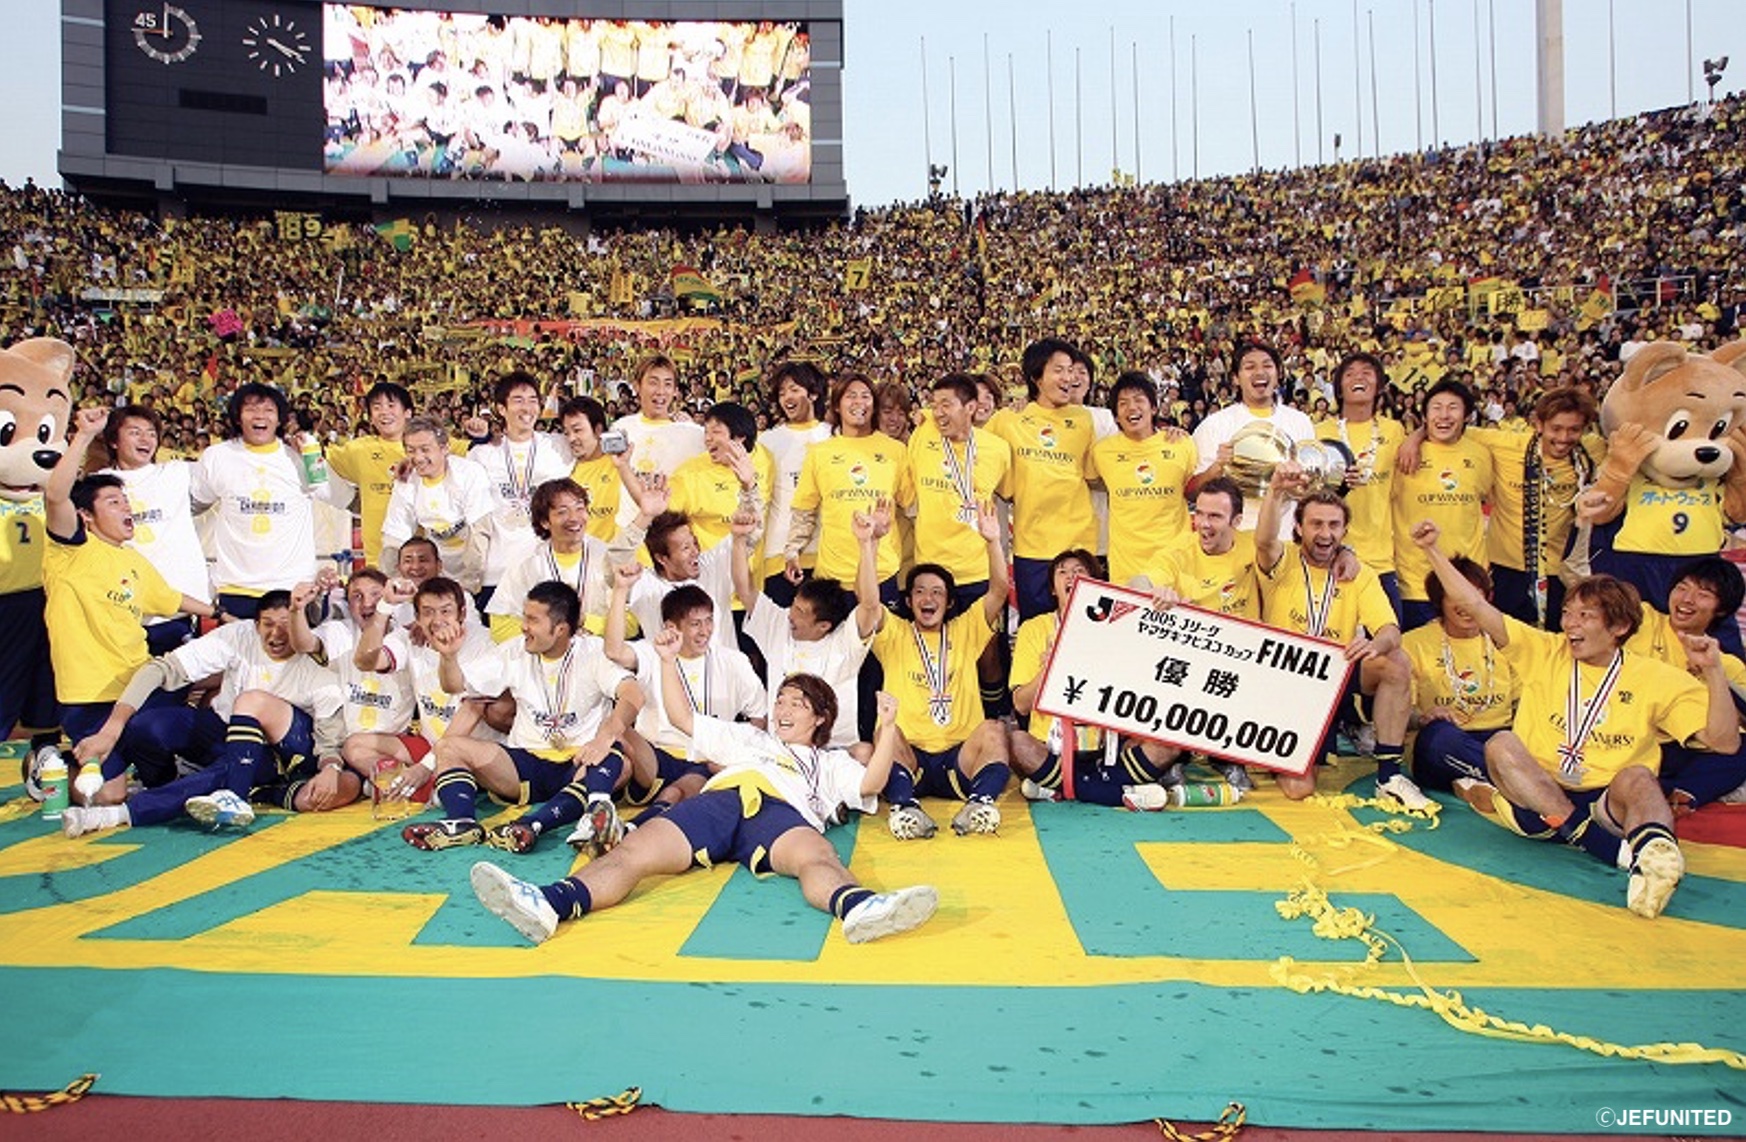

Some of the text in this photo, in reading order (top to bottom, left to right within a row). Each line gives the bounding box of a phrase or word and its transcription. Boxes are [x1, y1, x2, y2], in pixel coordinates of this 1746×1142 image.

[134, 12, 157, 28] 45
[852, 271, 864, 286] 7
[15, 521, 31, 544] 2
[1672, 511, 1689, 535] 9
[1140, 607, 1178, 628] 2005
[1255, 638, 1332, 681] FINAL
[1097, 685, 1299, 759] 100,000,000
